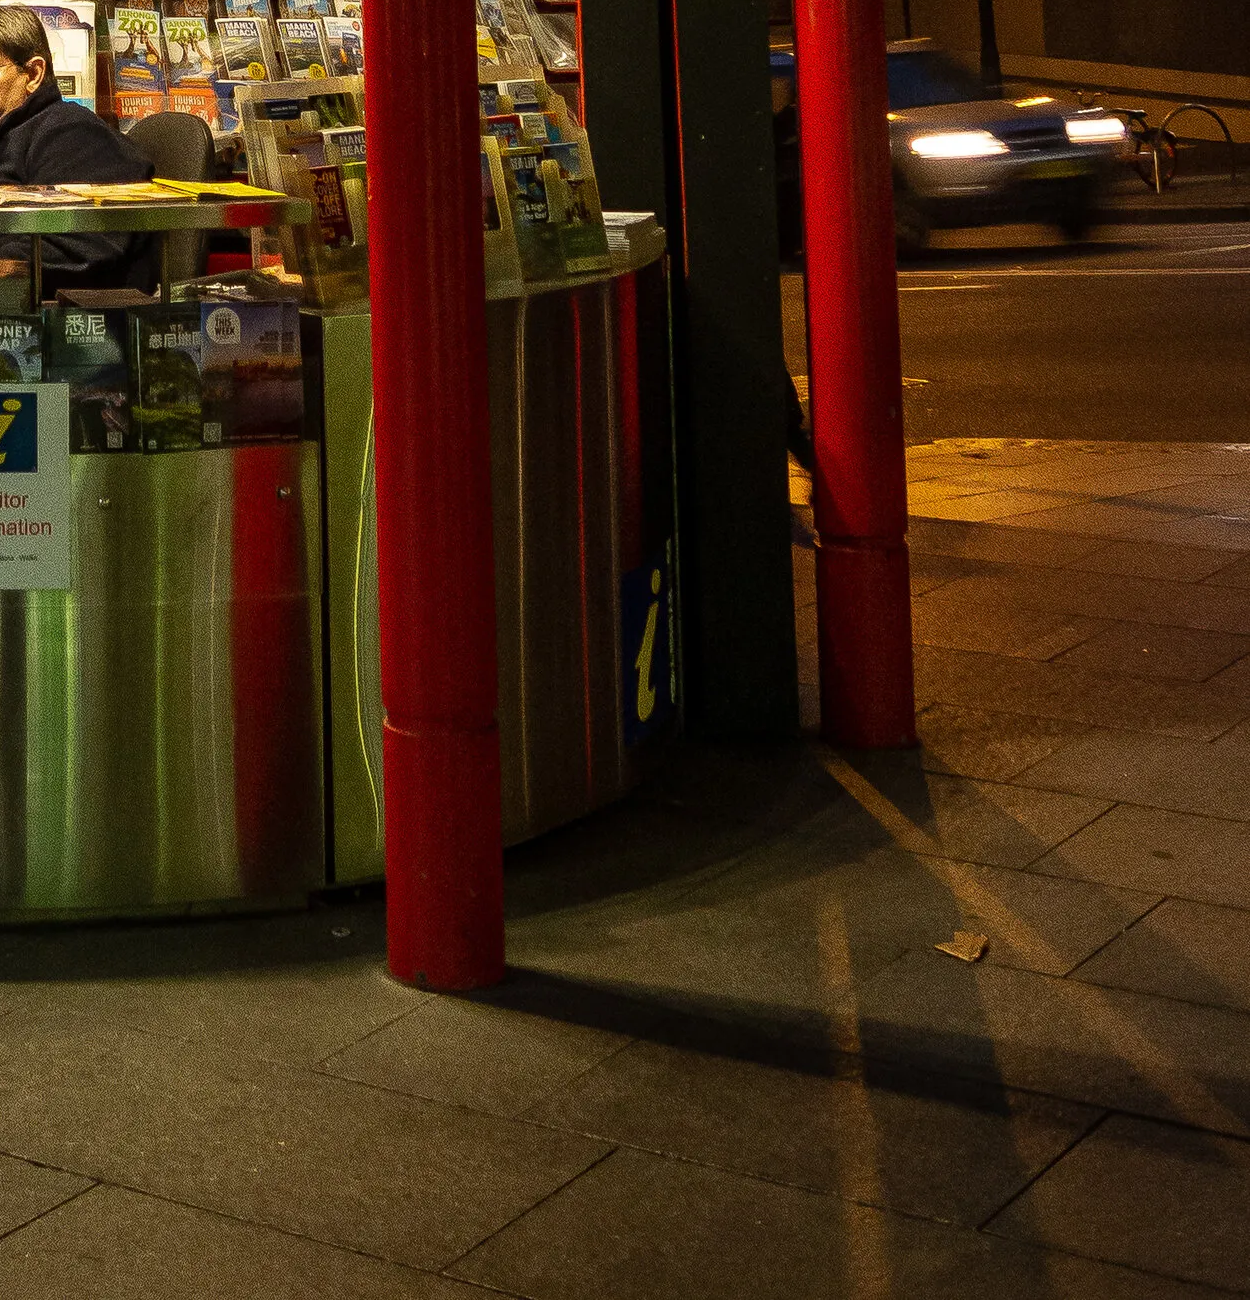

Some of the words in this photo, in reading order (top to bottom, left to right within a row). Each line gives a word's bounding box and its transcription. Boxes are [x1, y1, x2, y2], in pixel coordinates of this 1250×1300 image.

[118, 11, 157, 20] TARONGA
[118, 17, 158, 34] ZOO
[166, 27, 206, 42] ZOO
[226, 29, 258, 37] BEACH
[288, 30, 317, 38] BEACH
[120, 97, 153, 106] TOURIST
[174, 97, 206, 105] TOURIST
[121, 107, 139, 116] MAP
[174, 105, 192, 113] MAP
[65, 314, 107, 337] 悉尼
[214, 317, 232, 327] THIS
[214, 327, 236, 336] WEEK
